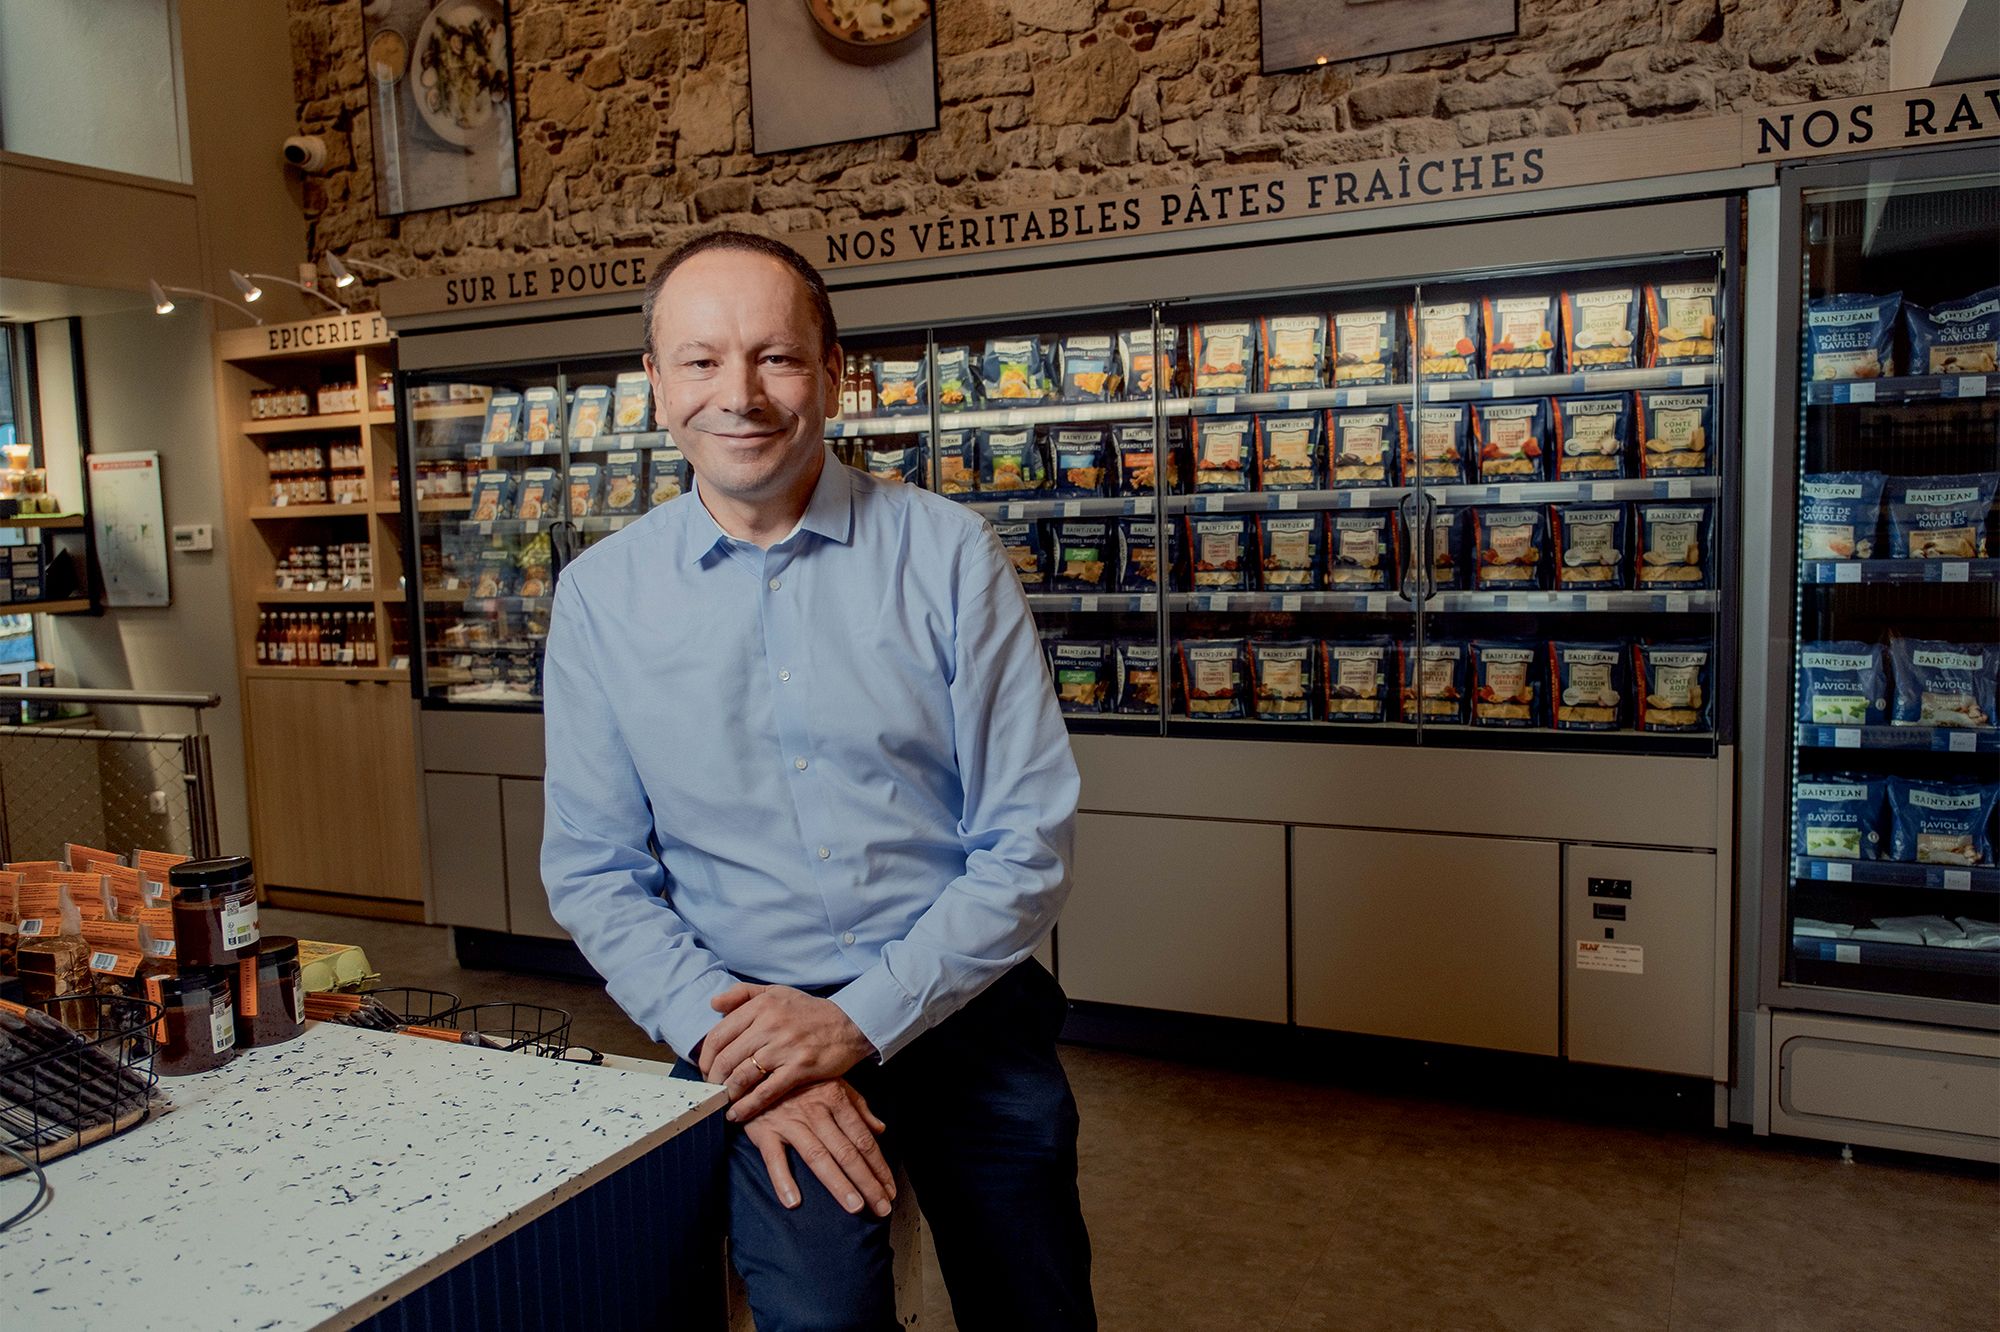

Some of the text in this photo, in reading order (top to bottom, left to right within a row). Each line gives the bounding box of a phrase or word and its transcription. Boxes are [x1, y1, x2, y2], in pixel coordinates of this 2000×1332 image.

[1757, 104, 1873, 154] NOS
[826, 148, 1545, 263] NOS VÉRITABLES PÂTES FRAÎCHES
[446, 257, 647, 306] SUR LE POUCE
[1977, 322, 1990, 331] DE
[268, 320, 363, 350] EPICERIE
[1858, 332, 1872, 340] DE
[1940, 332, 1988, 343] RAVIOLES
[1820, 340, 1869, 350] RAVIOLES
[1918, 518, 1965, 528] RAVIOLES
[1813, 681, 1863, 691] RAVIOLES
[1925, 680, 1973, 691] RAVIOLES
[1807, 812, 1858, 823] RAVIOLES
[1920, 820, 1970, 831] RAVIOLES
